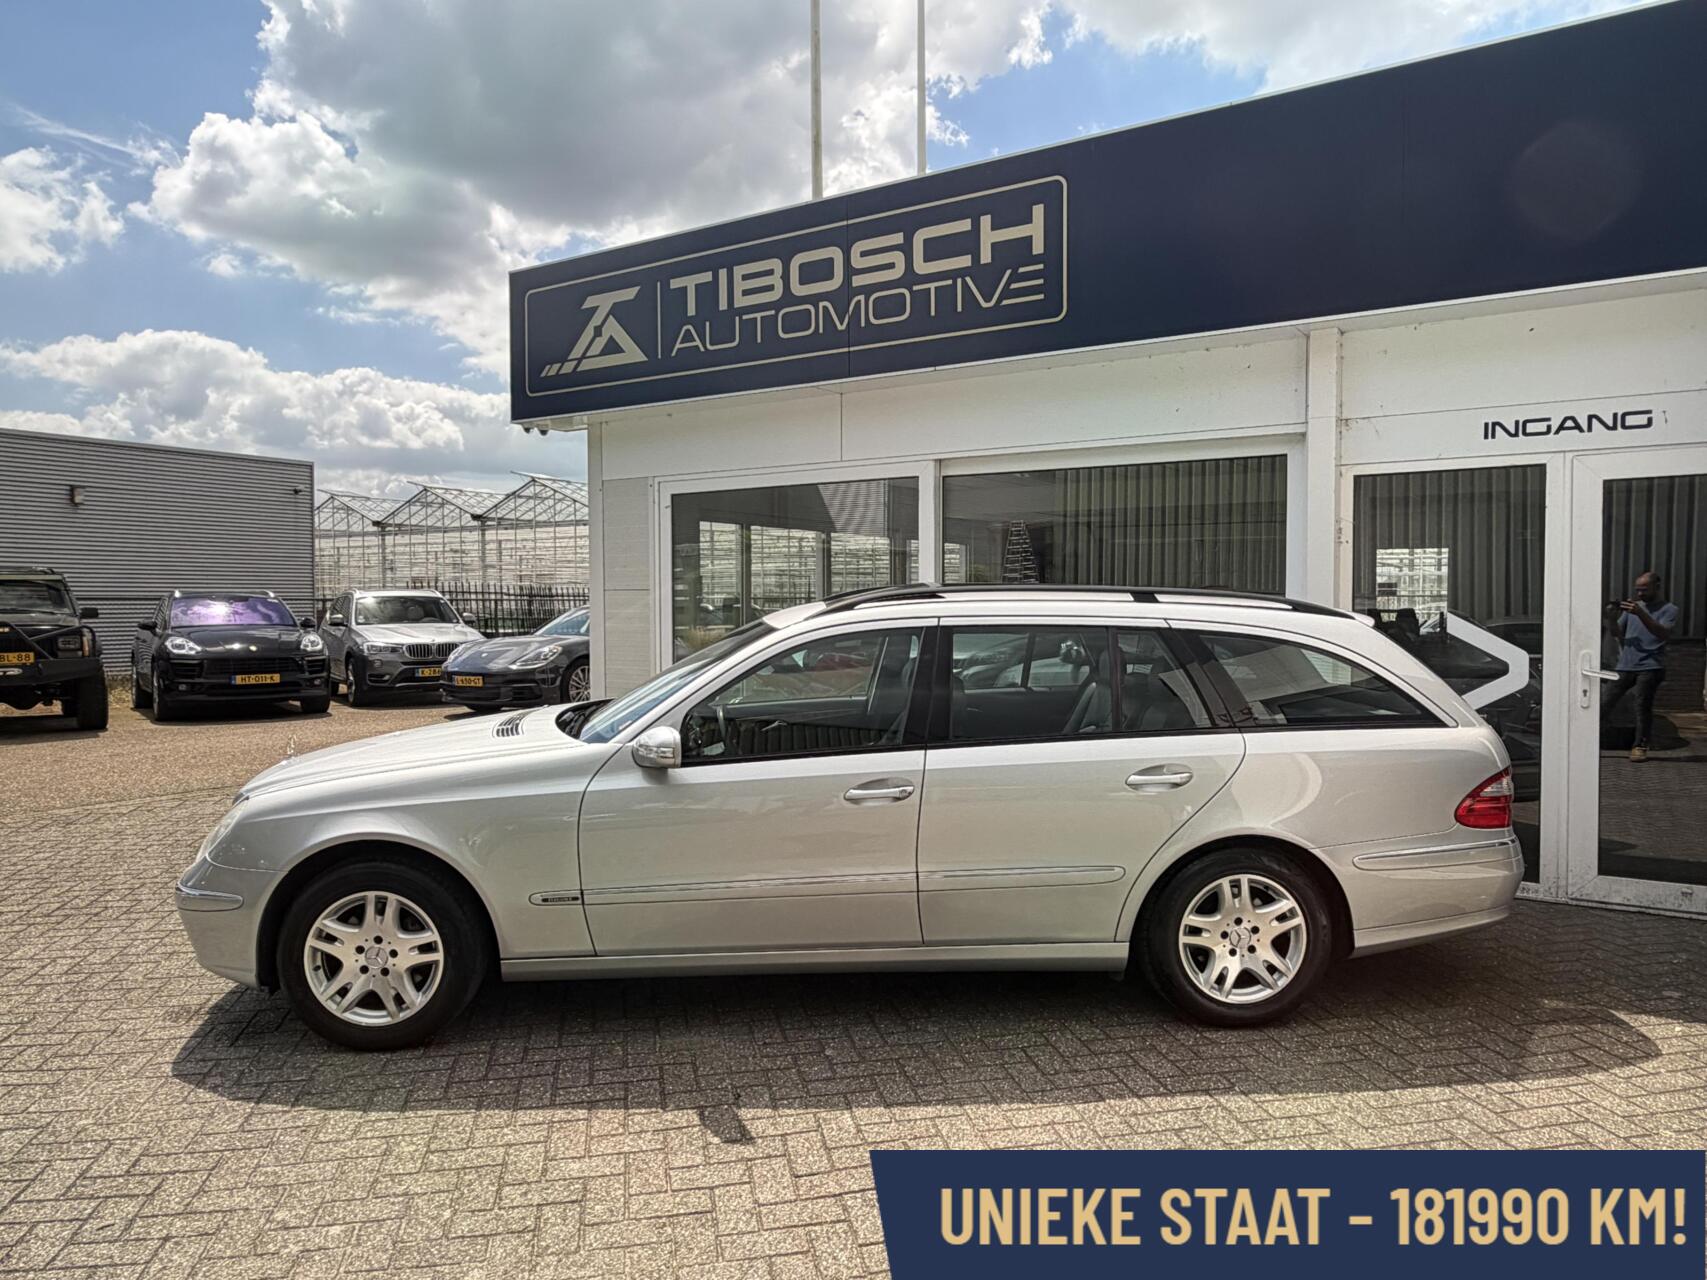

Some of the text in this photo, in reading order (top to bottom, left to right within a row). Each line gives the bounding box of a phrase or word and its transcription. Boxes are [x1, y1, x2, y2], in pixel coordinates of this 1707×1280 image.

[669, 203, 1045, 317] TIBOSCH
[671, 263, 1045, 357] AUTOMOTIVE
[1483, 409, 1654, 440] INGANG
